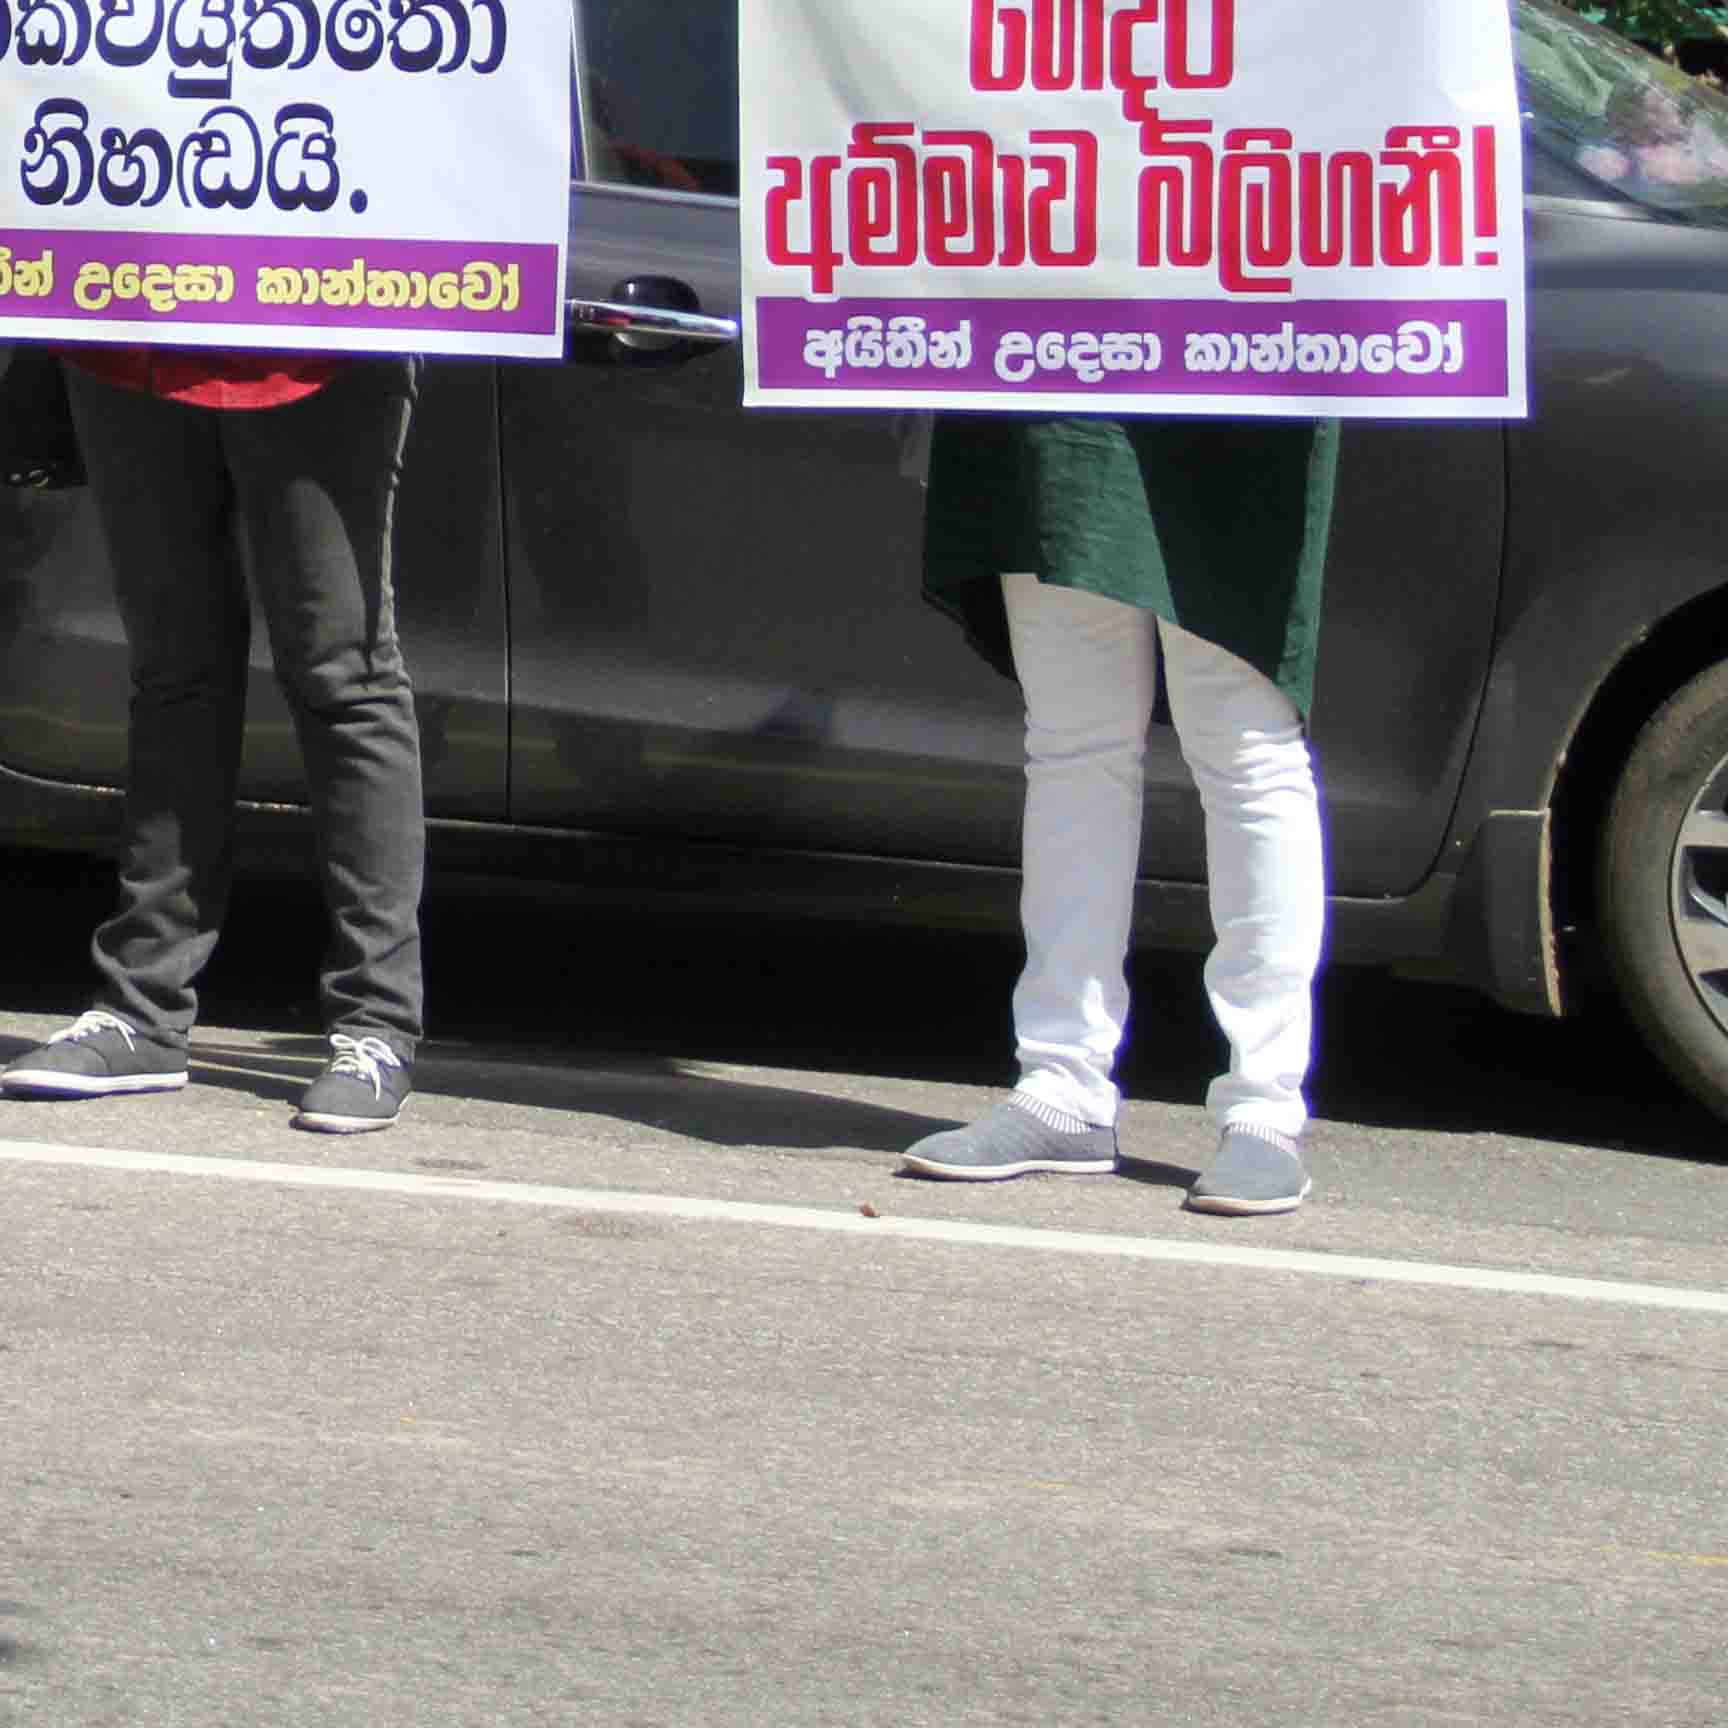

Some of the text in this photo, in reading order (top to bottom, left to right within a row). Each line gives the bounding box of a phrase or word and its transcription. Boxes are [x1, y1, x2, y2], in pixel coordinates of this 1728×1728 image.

[20, 96, 368, 214] නිහඬයි.
[765, 121, 1099, 294] අම්මාව
[74, 260, 234, 313] උදෙසා
[255, 257, 520, 310] කාන්තාවෝ
[995, 329, 1161, 382] උදෙසා
[1184, 320, 1463, 373] කාන්තාවෝ
